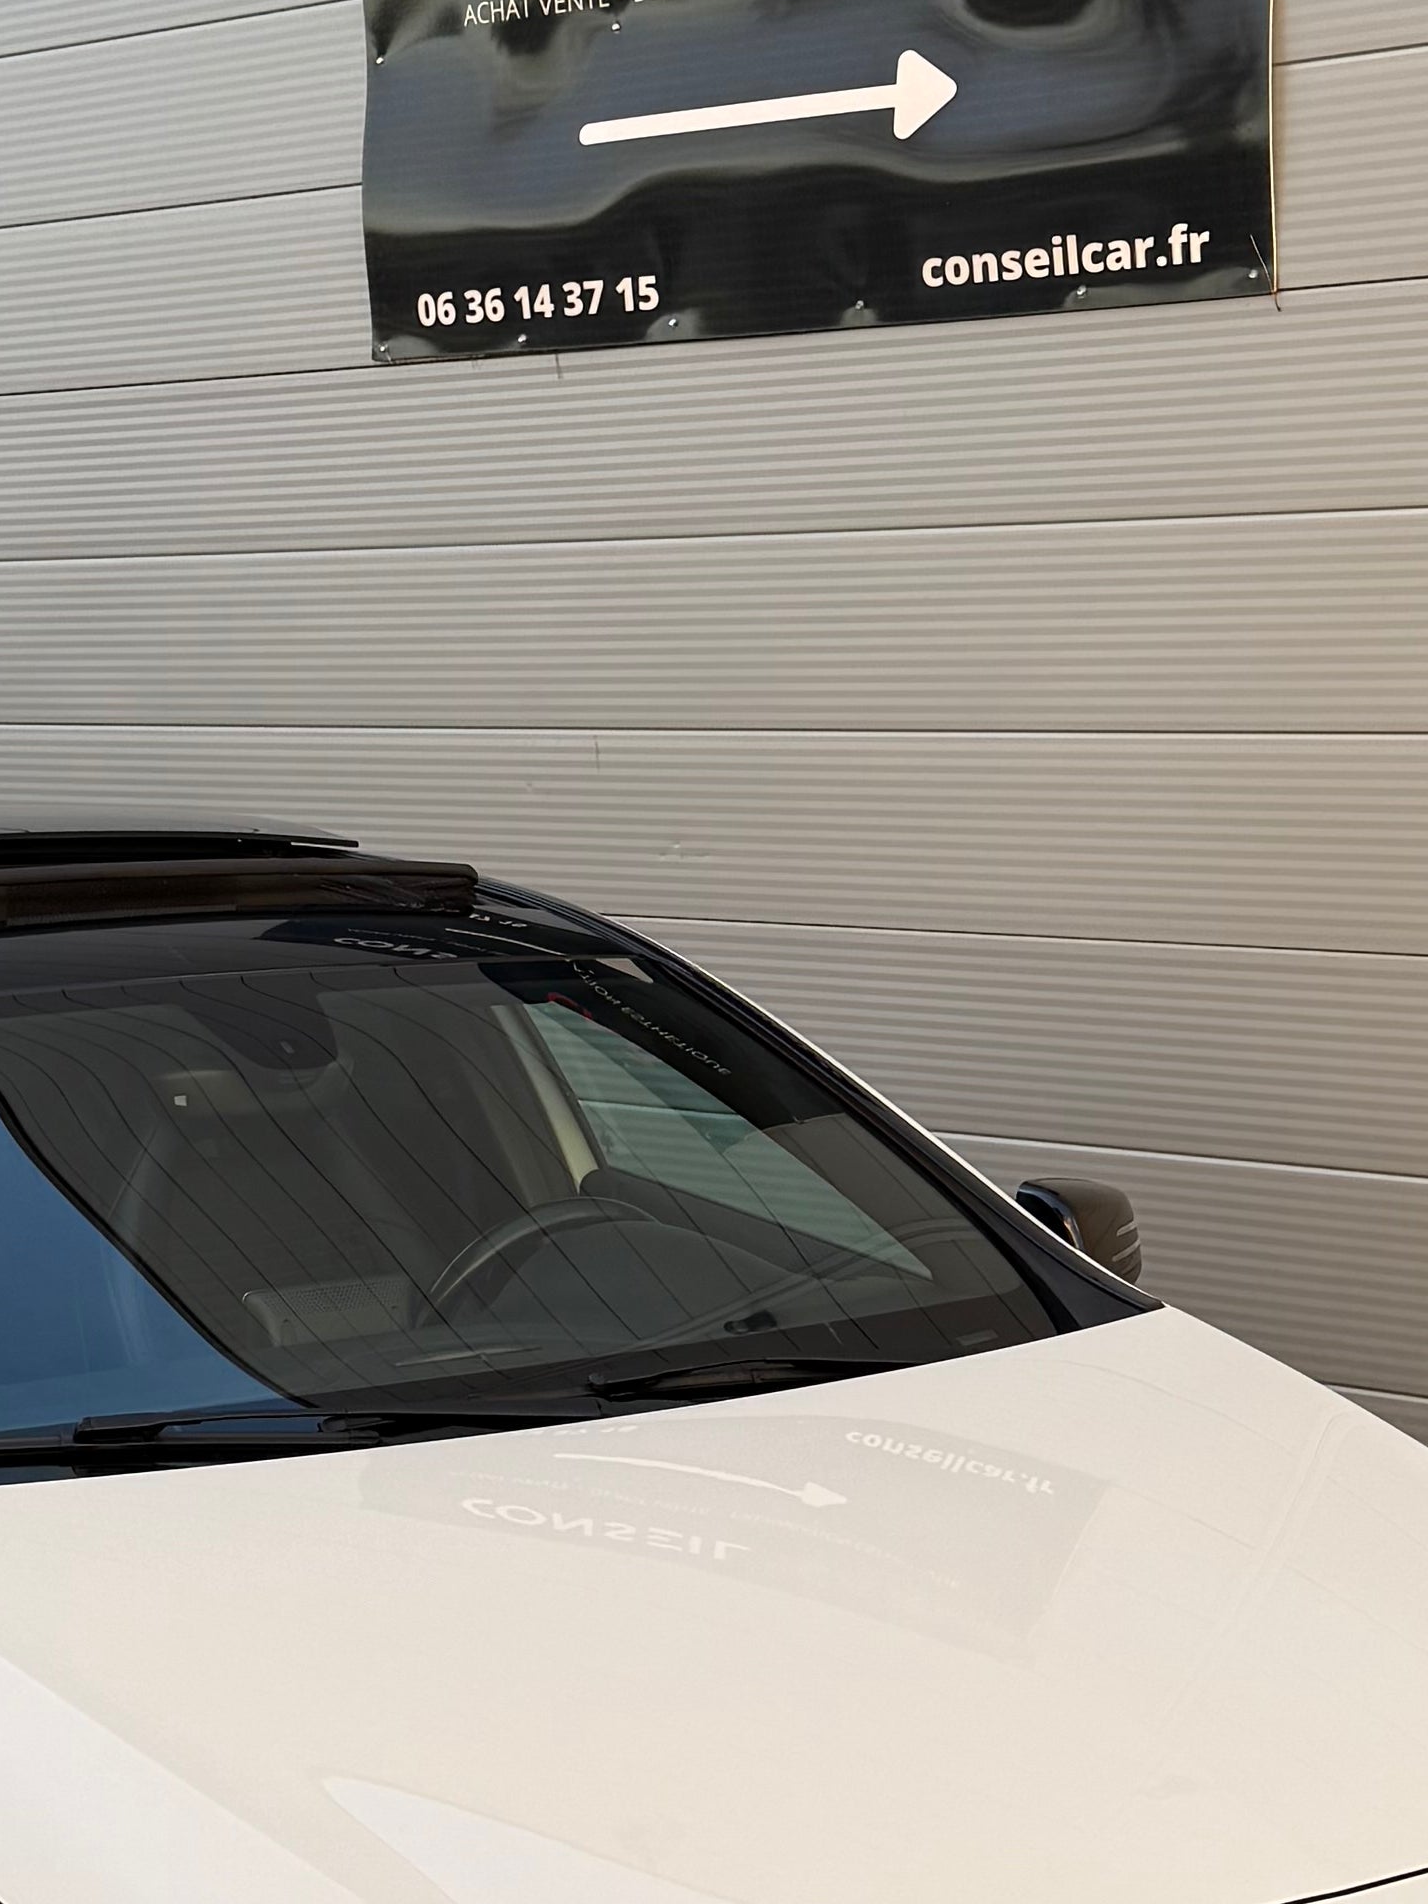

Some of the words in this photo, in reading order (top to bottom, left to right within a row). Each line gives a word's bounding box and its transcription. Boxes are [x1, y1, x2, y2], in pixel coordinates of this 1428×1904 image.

[922, 223, 1210, 287] conseilcar.fr
[417, 291, 456, 327] 06
[463, 287, 505, 323] 36
[513, 283, 555, 320] 14
[562, 279, 604, 317] 37
[615, 275, 659, 312] 15
